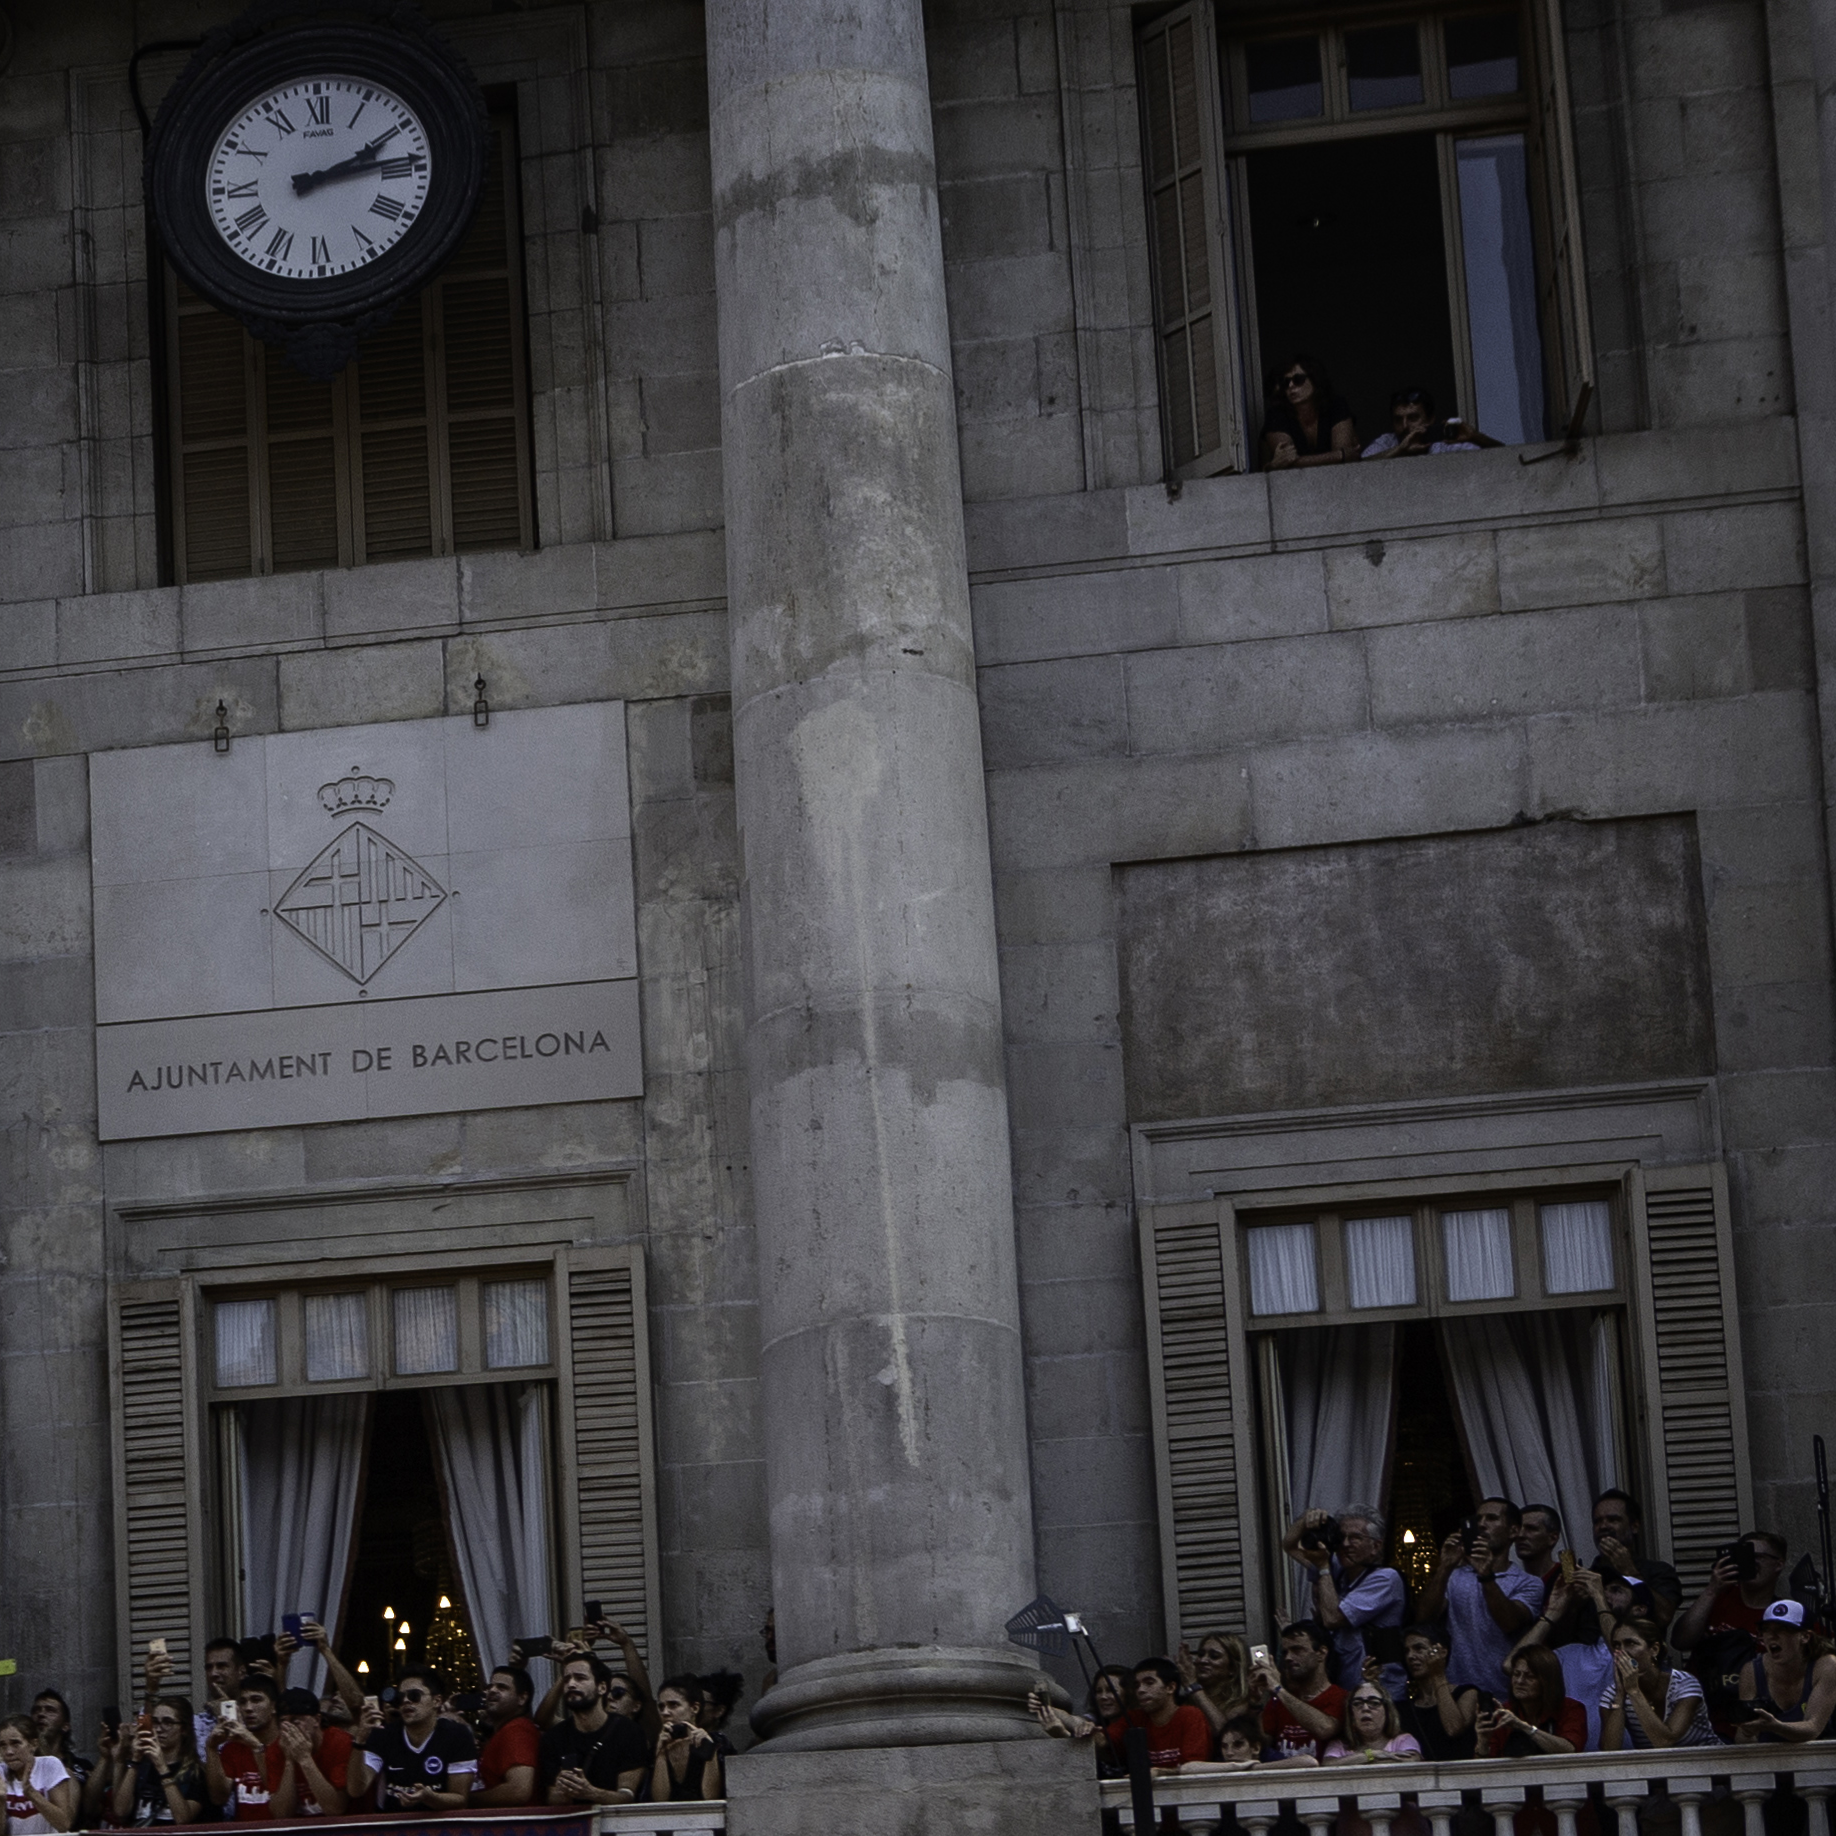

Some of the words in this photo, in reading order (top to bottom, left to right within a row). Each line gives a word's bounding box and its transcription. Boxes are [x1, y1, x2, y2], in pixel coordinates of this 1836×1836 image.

[127, 1052, 332, 1093] AJUNTAMENT
[352, 1047, 392, 1074] DE
[411, 1030, 611, 1068] BARCELONA
